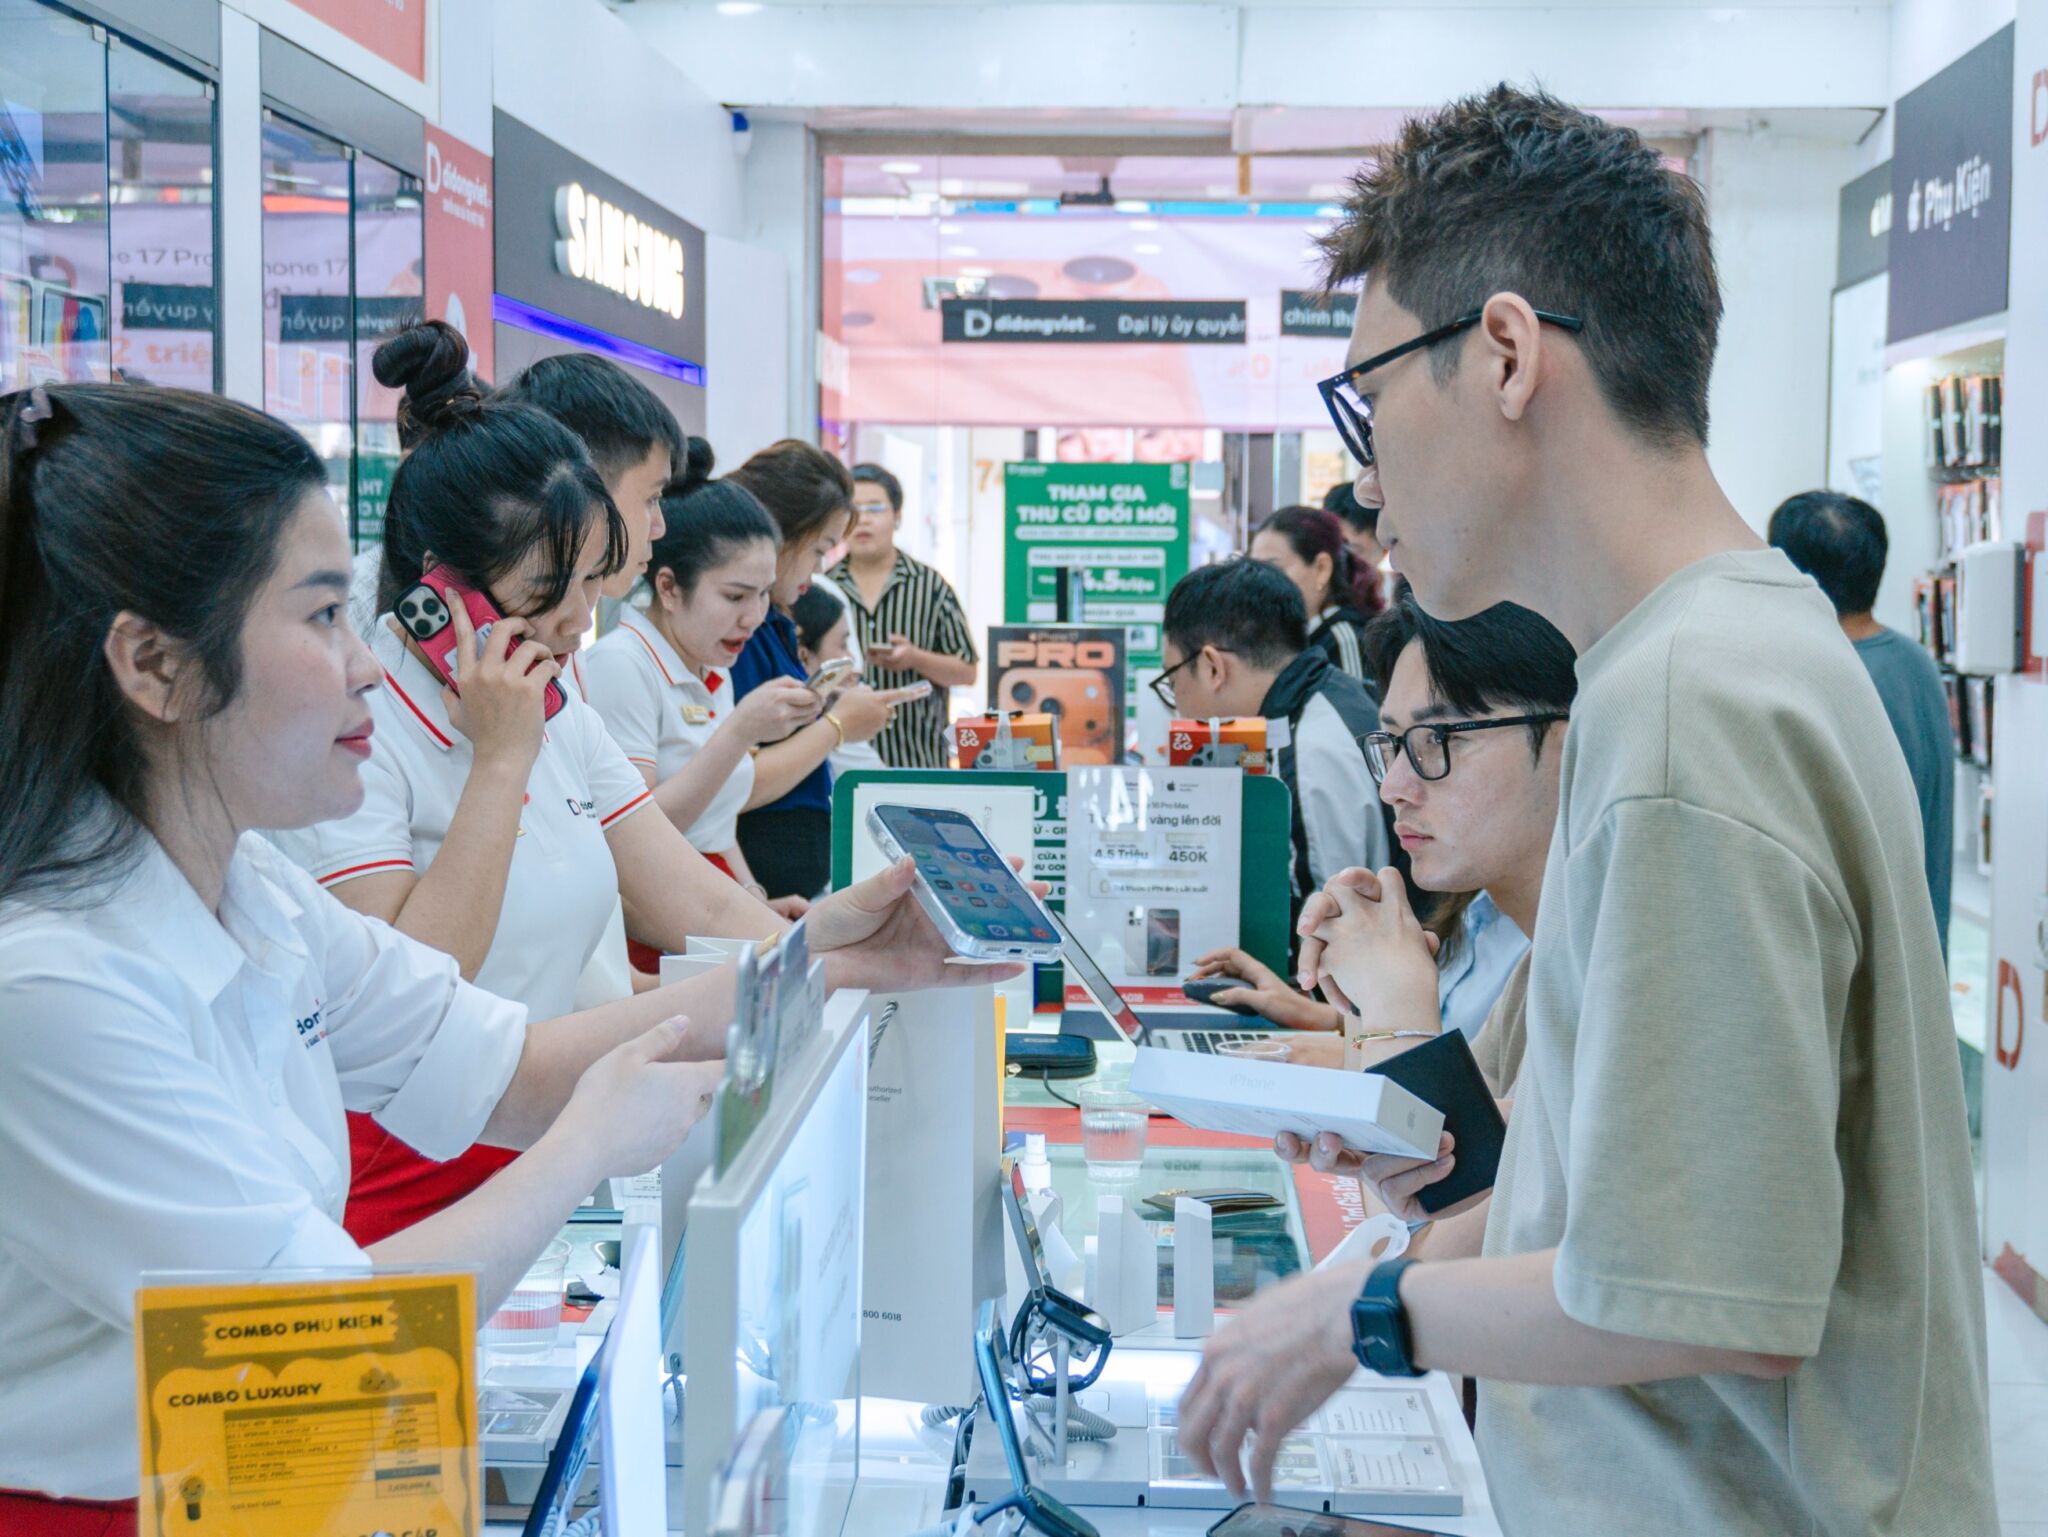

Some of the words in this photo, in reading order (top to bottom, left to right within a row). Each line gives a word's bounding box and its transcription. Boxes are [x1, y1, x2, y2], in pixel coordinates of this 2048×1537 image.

[555, 182, 684, 320] SAMSUNG
[1047, 484, 1107, 501] THAM
[1109, 484, 1147, 501] GIA
[1017, 505, 1060, 523] THU
[997, 641, 1115, 668] PRO
[1150, 814, 1178, 827] vàng
[1181, 814, 1199, 826] lên
[1169, 850, 1208, 862] 450K
[214, 1323, 287, 1341] COMBO
[168, 1389, 240, 1408] COMBO
[245, 1382, 323, 1402] LUXURY
